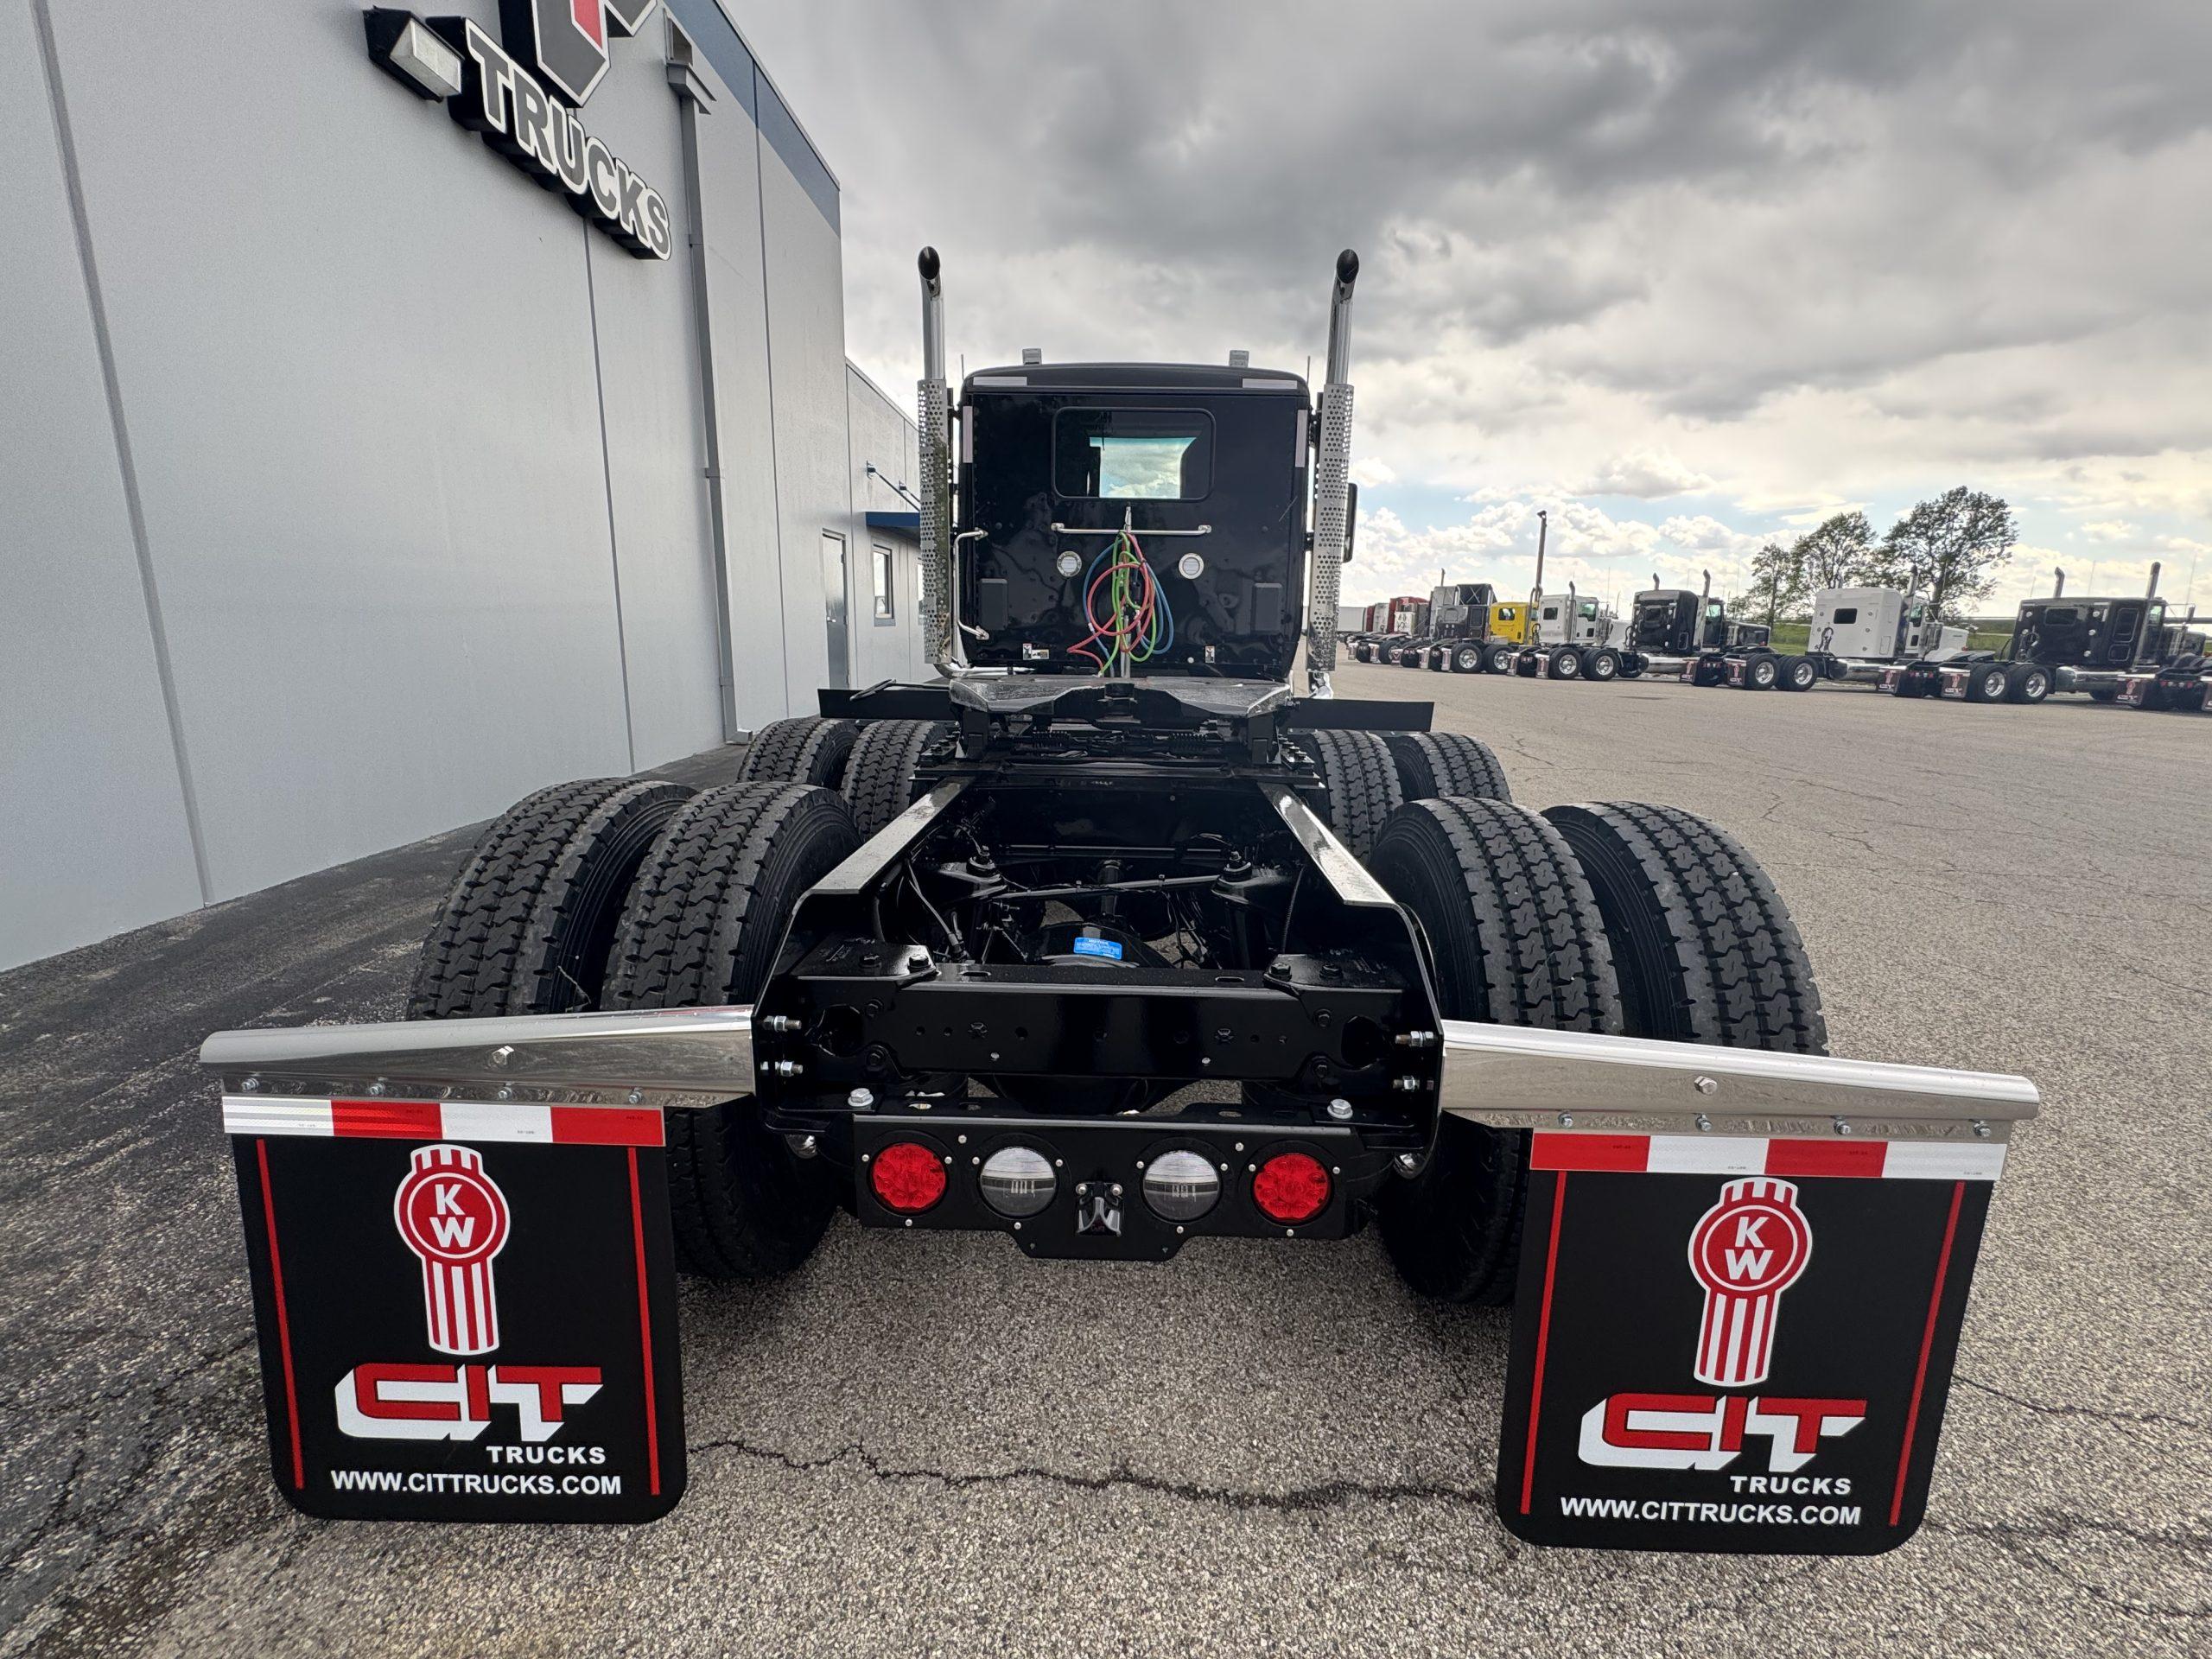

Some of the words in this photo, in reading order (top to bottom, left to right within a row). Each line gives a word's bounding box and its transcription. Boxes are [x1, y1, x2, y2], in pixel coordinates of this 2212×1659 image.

[466, 17, 672, 261] TRUCKS
[435, 1184, 466, 1215] K
[429, 1217, 475, 1248] W
[1734, 1216, 1770, 1248] K
[1725, 1249, 1774, 1280] W
[334, 1363, 604, 1441] CIT
[1578, 1392, 1867, 1472] CIT
[486, 1446, 606, 1464] TRUCKS
[330, 1470, 621, 1495] WWW.CITTRUCKS.COM
[1730, 1475, 1852, 1495] TRUCKS
[1560, 1497, 1861, 1525] WWW.CITTRUCKS.COM
